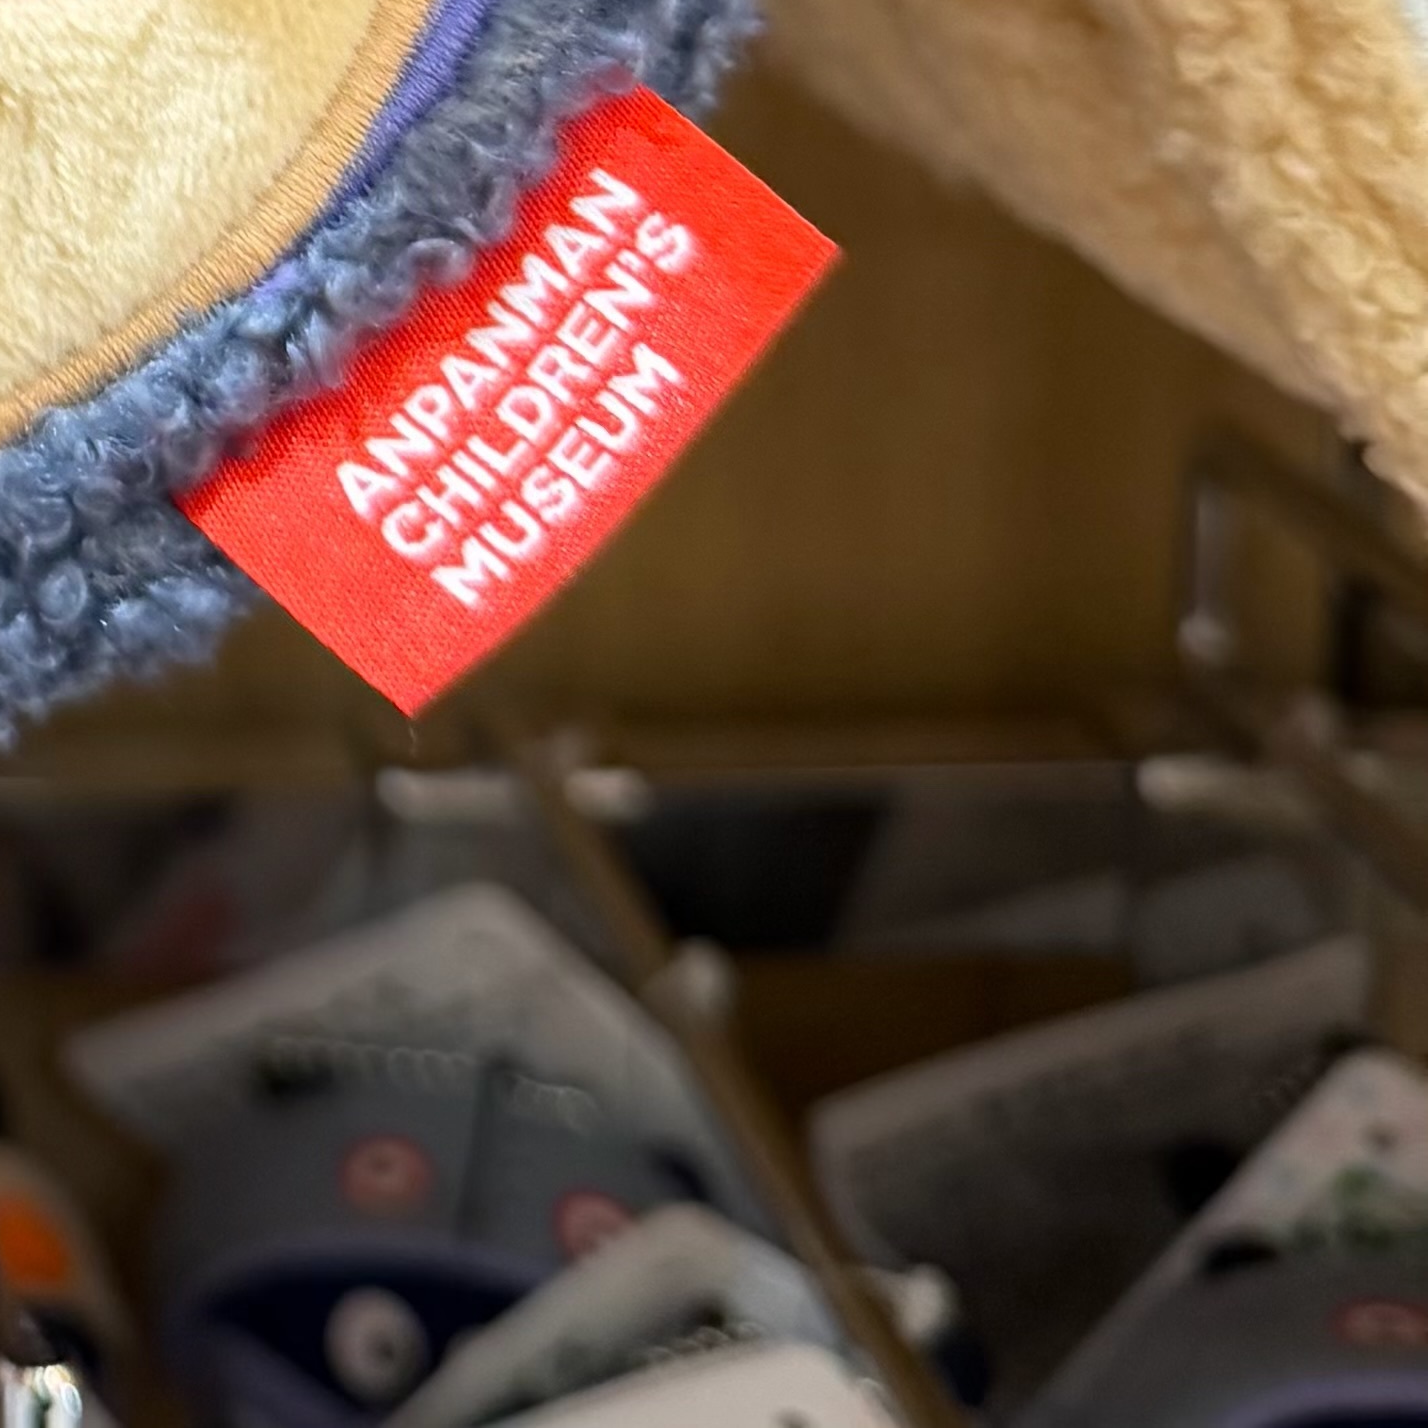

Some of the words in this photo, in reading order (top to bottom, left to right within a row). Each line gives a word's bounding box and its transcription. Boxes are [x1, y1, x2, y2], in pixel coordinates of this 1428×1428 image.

[336, 168, 642, 522] ANPANMAN
[380, 212, 693, 559] CHILDREN'S
[430, 342, 684, 608] MUSEUM
